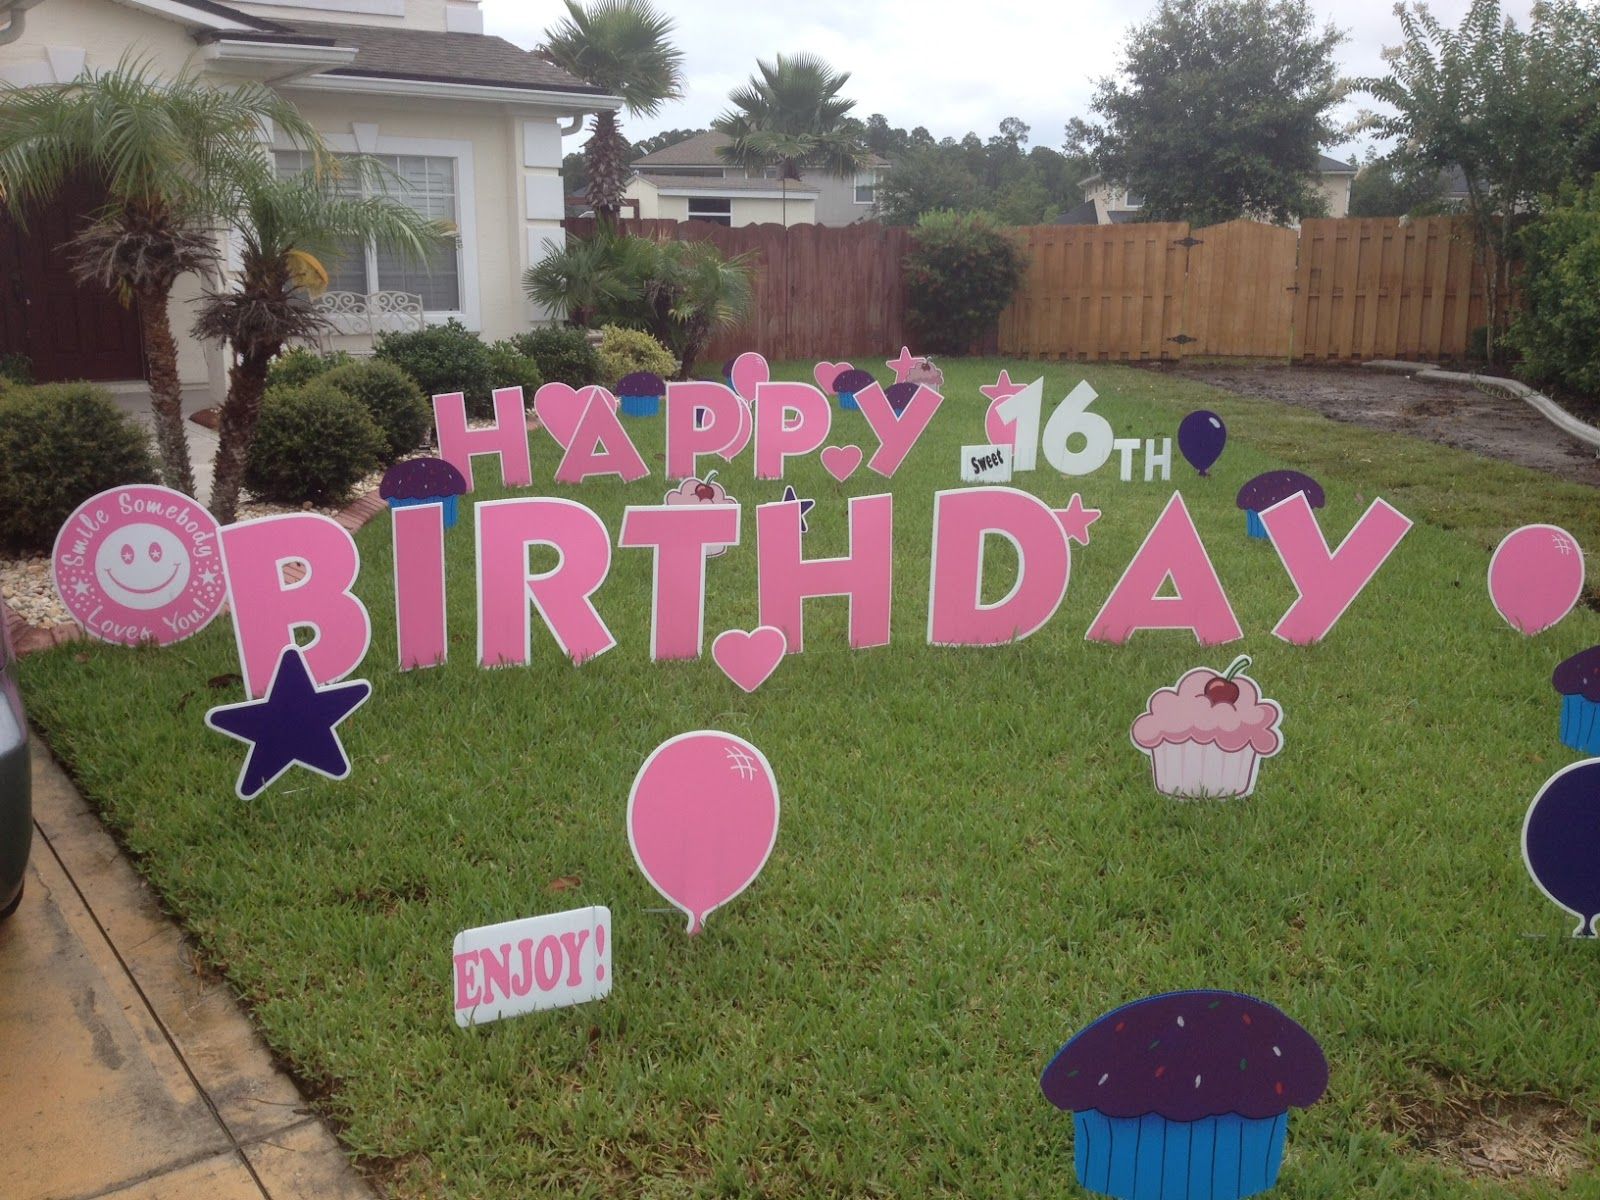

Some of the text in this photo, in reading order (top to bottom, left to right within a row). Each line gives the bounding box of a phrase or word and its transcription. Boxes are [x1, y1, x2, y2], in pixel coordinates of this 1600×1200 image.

[432, 380, 945, 493] HAPPY
[971, 448, 1004, 475] Sweet
[61, 492, 215, 567] Smile Somebody
[87, 598, 210, 640] Loves You!
[217, 486, 1414, 701] BIRTHDAY
[453, 924, 606, 1010] ENJOY!
